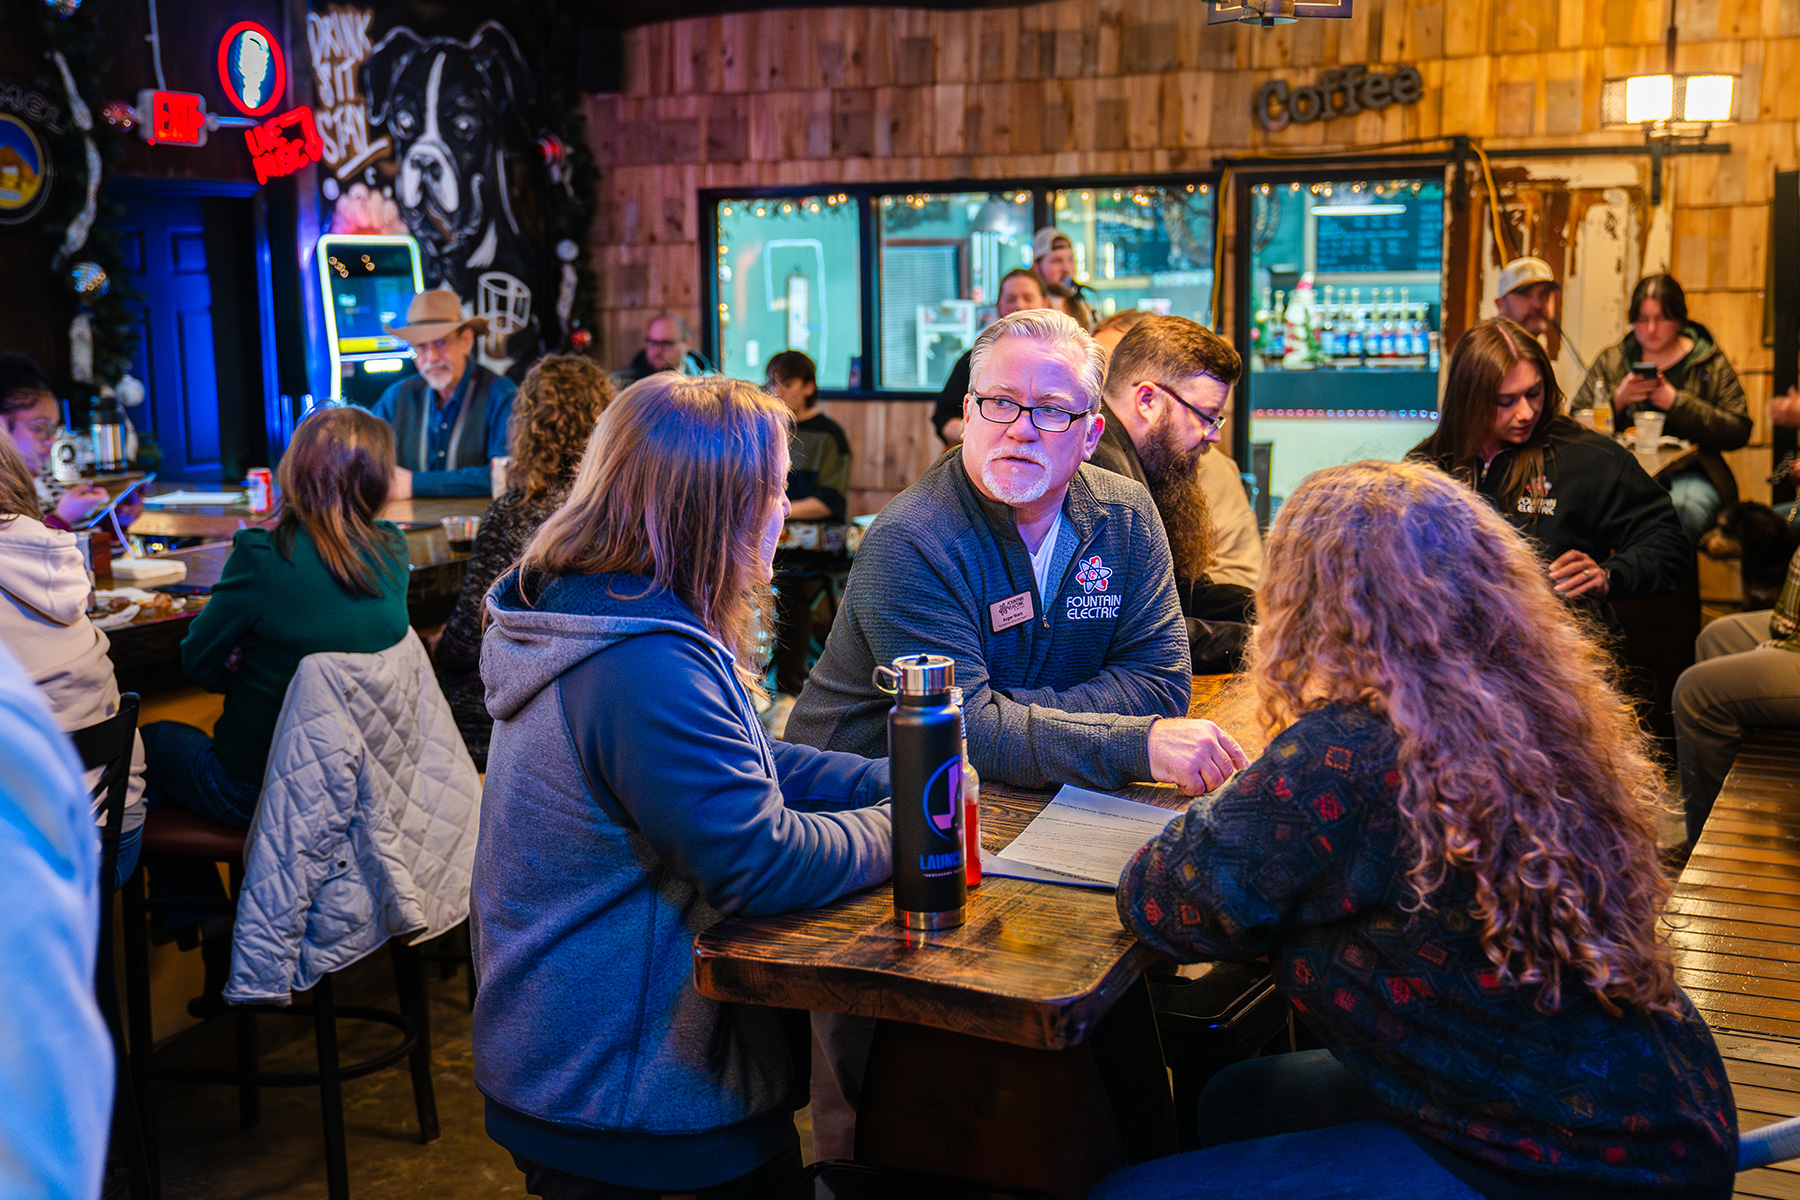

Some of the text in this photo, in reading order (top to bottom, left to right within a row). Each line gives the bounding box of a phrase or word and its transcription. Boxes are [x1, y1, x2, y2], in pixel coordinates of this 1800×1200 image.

[305, 10, 373, 67] DRINK
[317, 57, 357, 109] SIT
[1257, 65, 1424, 132] Coffee
[153, 91, 200, 144] EXIT
[315, 103, 389, 179] STAY
[1066, 594, 1122, 608] FOUNTAIN
[1066, 606, 1120, 620] ELECTRIC
[919, 850, 962, 870] LAUNC
